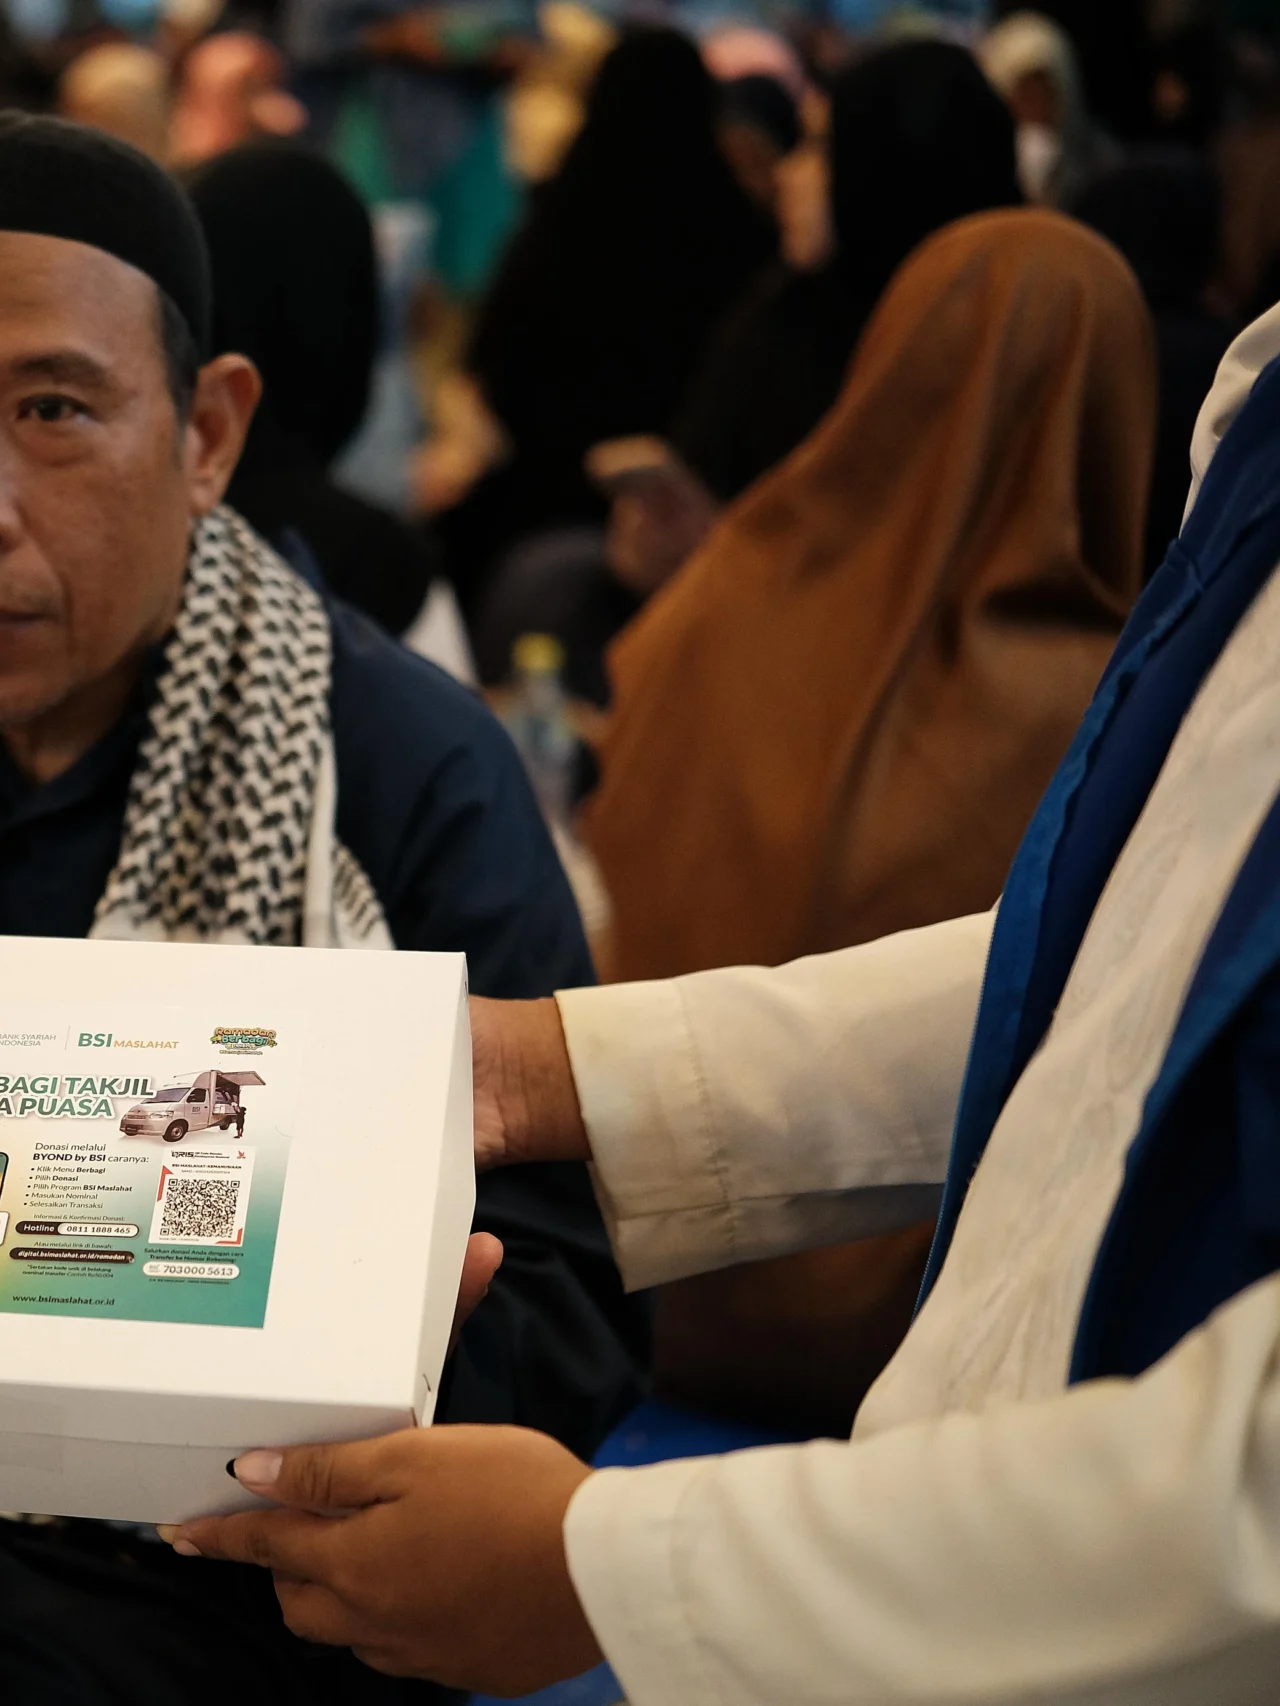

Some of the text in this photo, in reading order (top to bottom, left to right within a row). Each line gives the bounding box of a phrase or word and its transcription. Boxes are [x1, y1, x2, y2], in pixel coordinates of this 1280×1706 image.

[78, 1032, 179, 1049] BSI MASLAHAT
[64, 1077, 154, 1096] TAKJIL
[18, 1097, 112, 1117] PUASA
[35, 1142, 106, 1152] Donasi melalui
[32, 1153, 149, 1164] BYOND by BSI caranya:
[23, 1224, 55, 1232] Hotline
[66, 1225, 88, 1233] 0811
[12, 1295, 115, 1306] www.bsimaslahat.or.id
